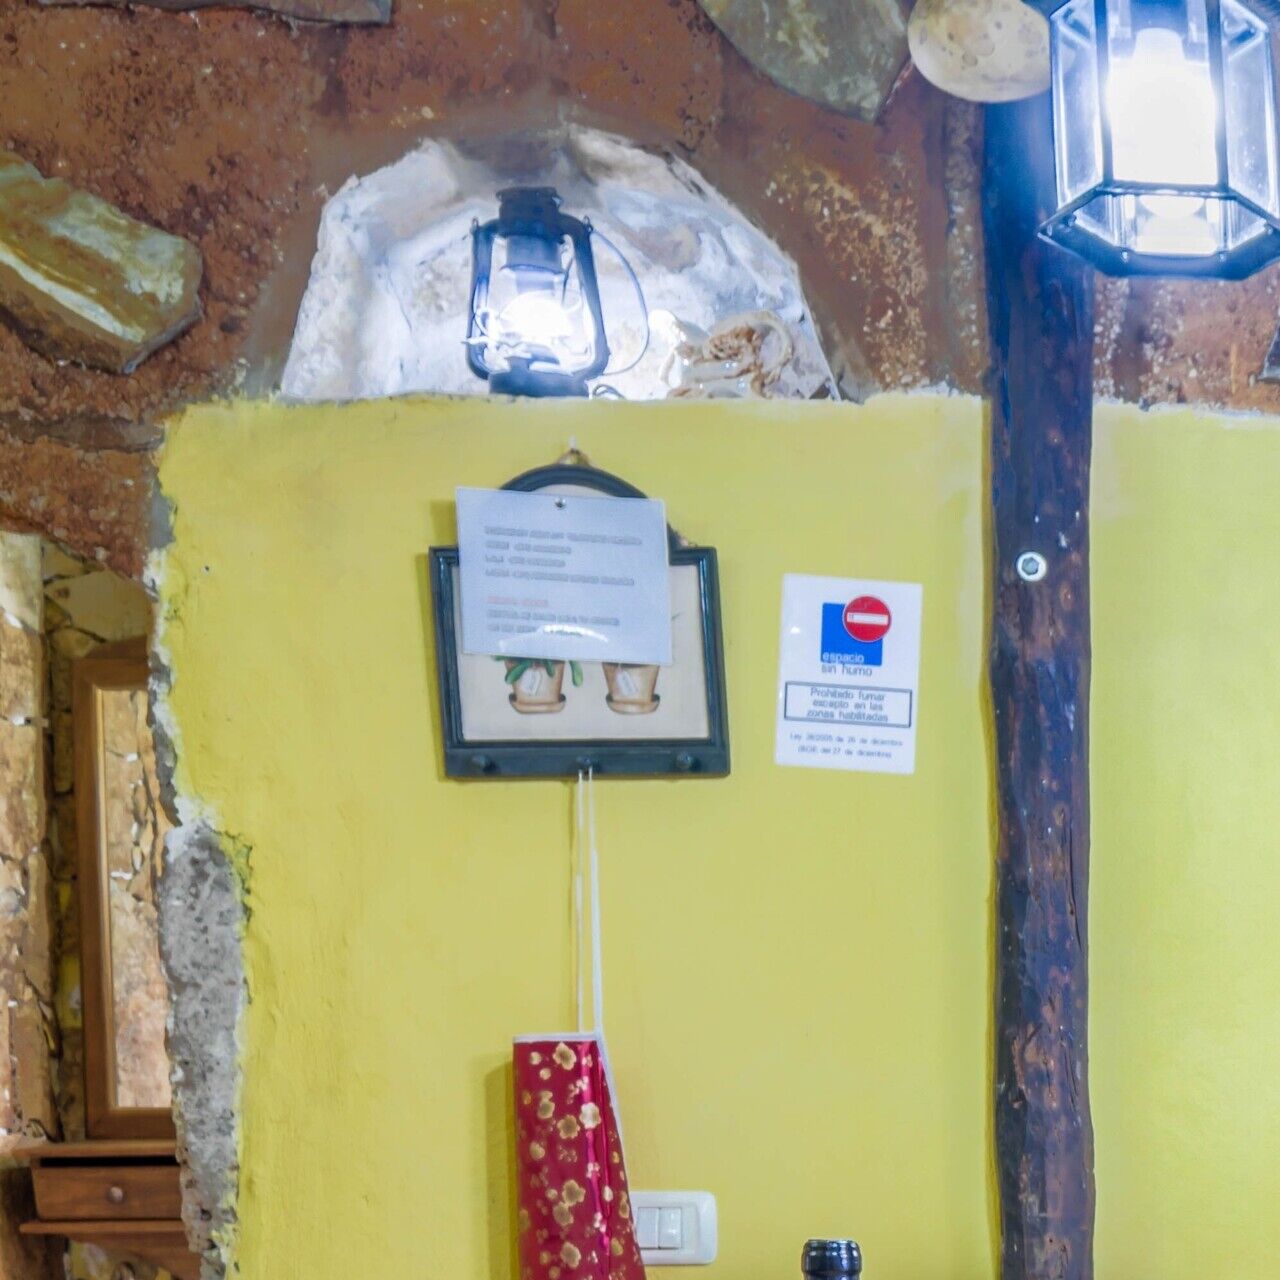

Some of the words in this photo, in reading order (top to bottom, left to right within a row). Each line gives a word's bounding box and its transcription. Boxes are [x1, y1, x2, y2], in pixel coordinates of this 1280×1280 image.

[823, 651, 865, 665] espacio
[821, 663, 836, 674] sin
[842, 663, 873, 677] humo
[810, 687, 854, 699] Prohibido
[858, 691, 886, 702] fumar
[806, 710, 834, 719] zonas
[838, 710, 889, 723] habilitadas
